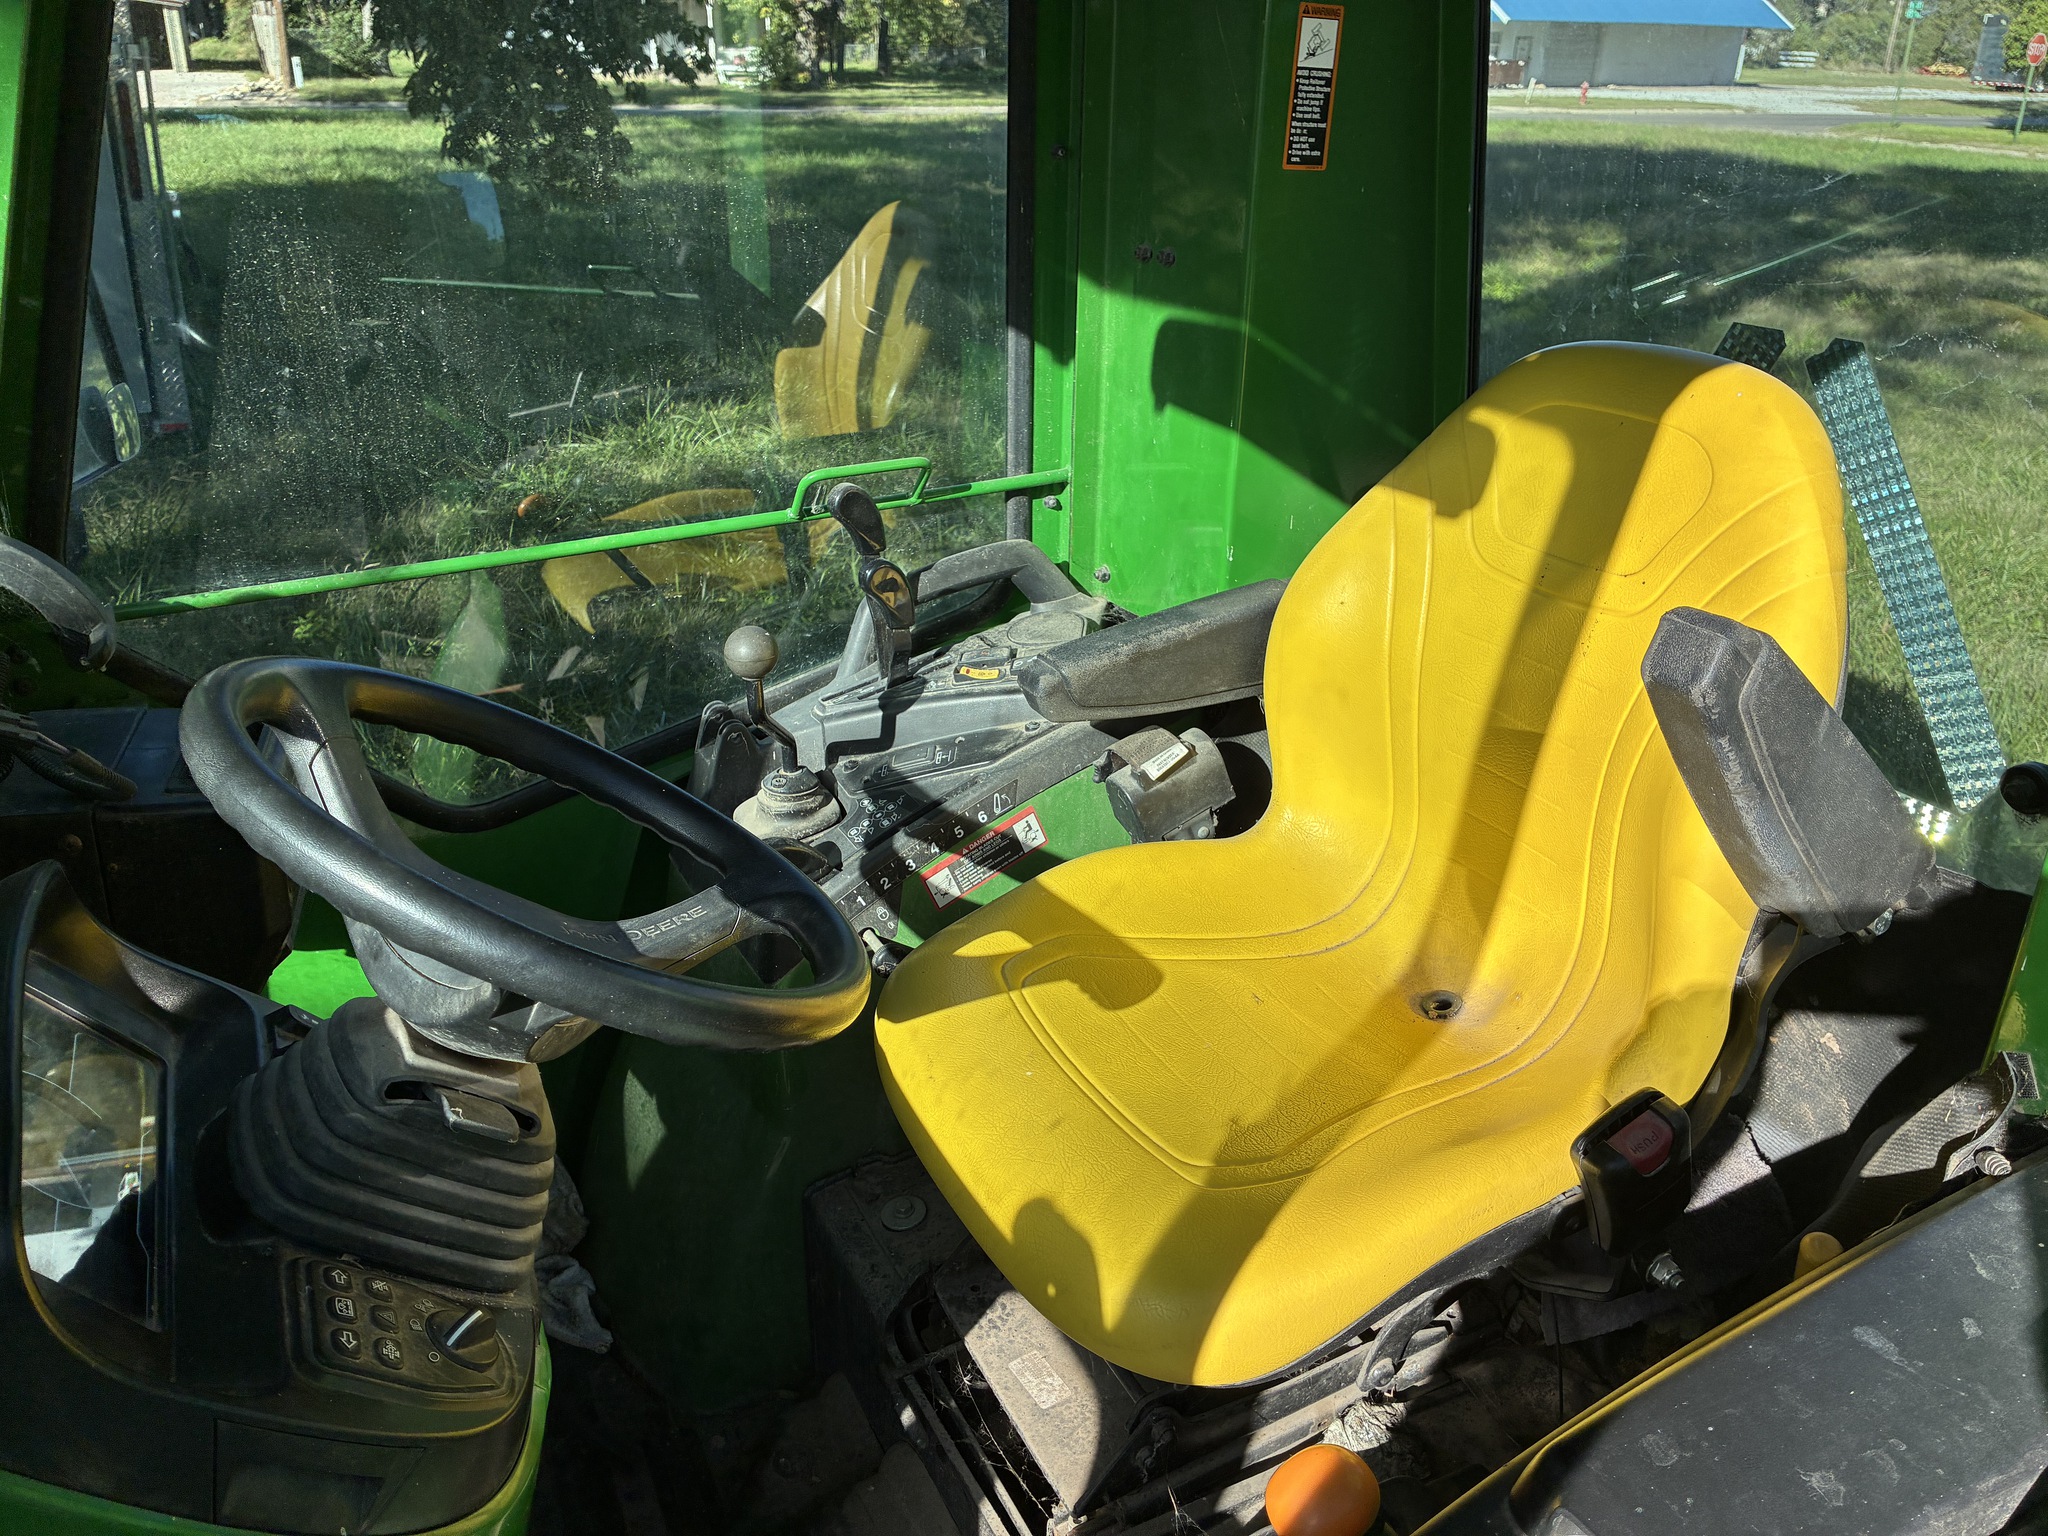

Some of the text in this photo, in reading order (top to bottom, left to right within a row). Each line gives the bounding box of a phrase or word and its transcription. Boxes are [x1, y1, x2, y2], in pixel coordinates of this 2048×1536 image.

[1311, 6, 1341, 17] WARNING
[2028, 43, 2047, 56] STOP
[968, 830, 995, 850] DANGER
[978, 838, 993, 850] BLADES
[855, 811, 988, 907] 1 2 3 4 5 6
[626, 905, 707, 941] DEERE
[1630, 1130, 1660, 1155] PUSH
